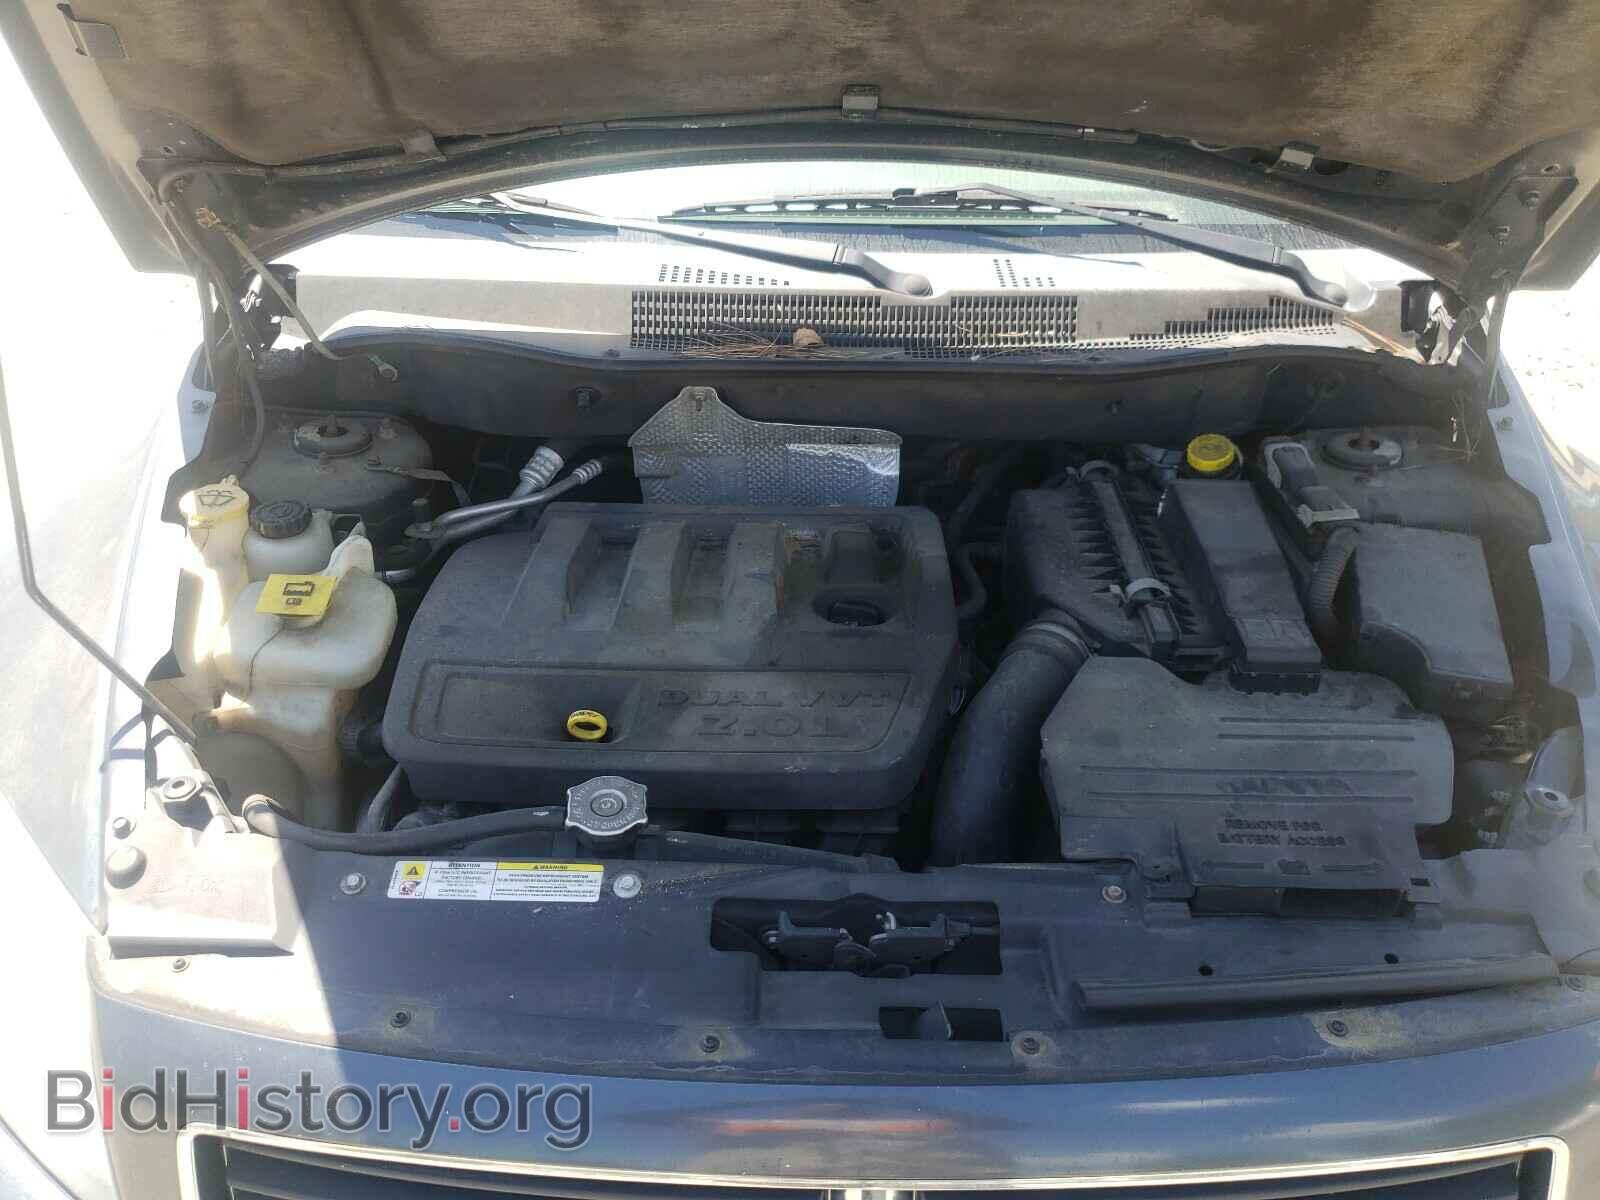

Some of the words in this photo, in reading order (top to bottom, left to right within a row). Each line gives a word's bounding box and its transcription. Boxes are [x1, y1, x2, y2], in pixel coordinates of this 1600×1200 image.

[1224, 818, 1289, 831] REMOVE
[1217, 832, 1281, 846] BATTERY
[1287, 835, 1348, 847] ACCESS
